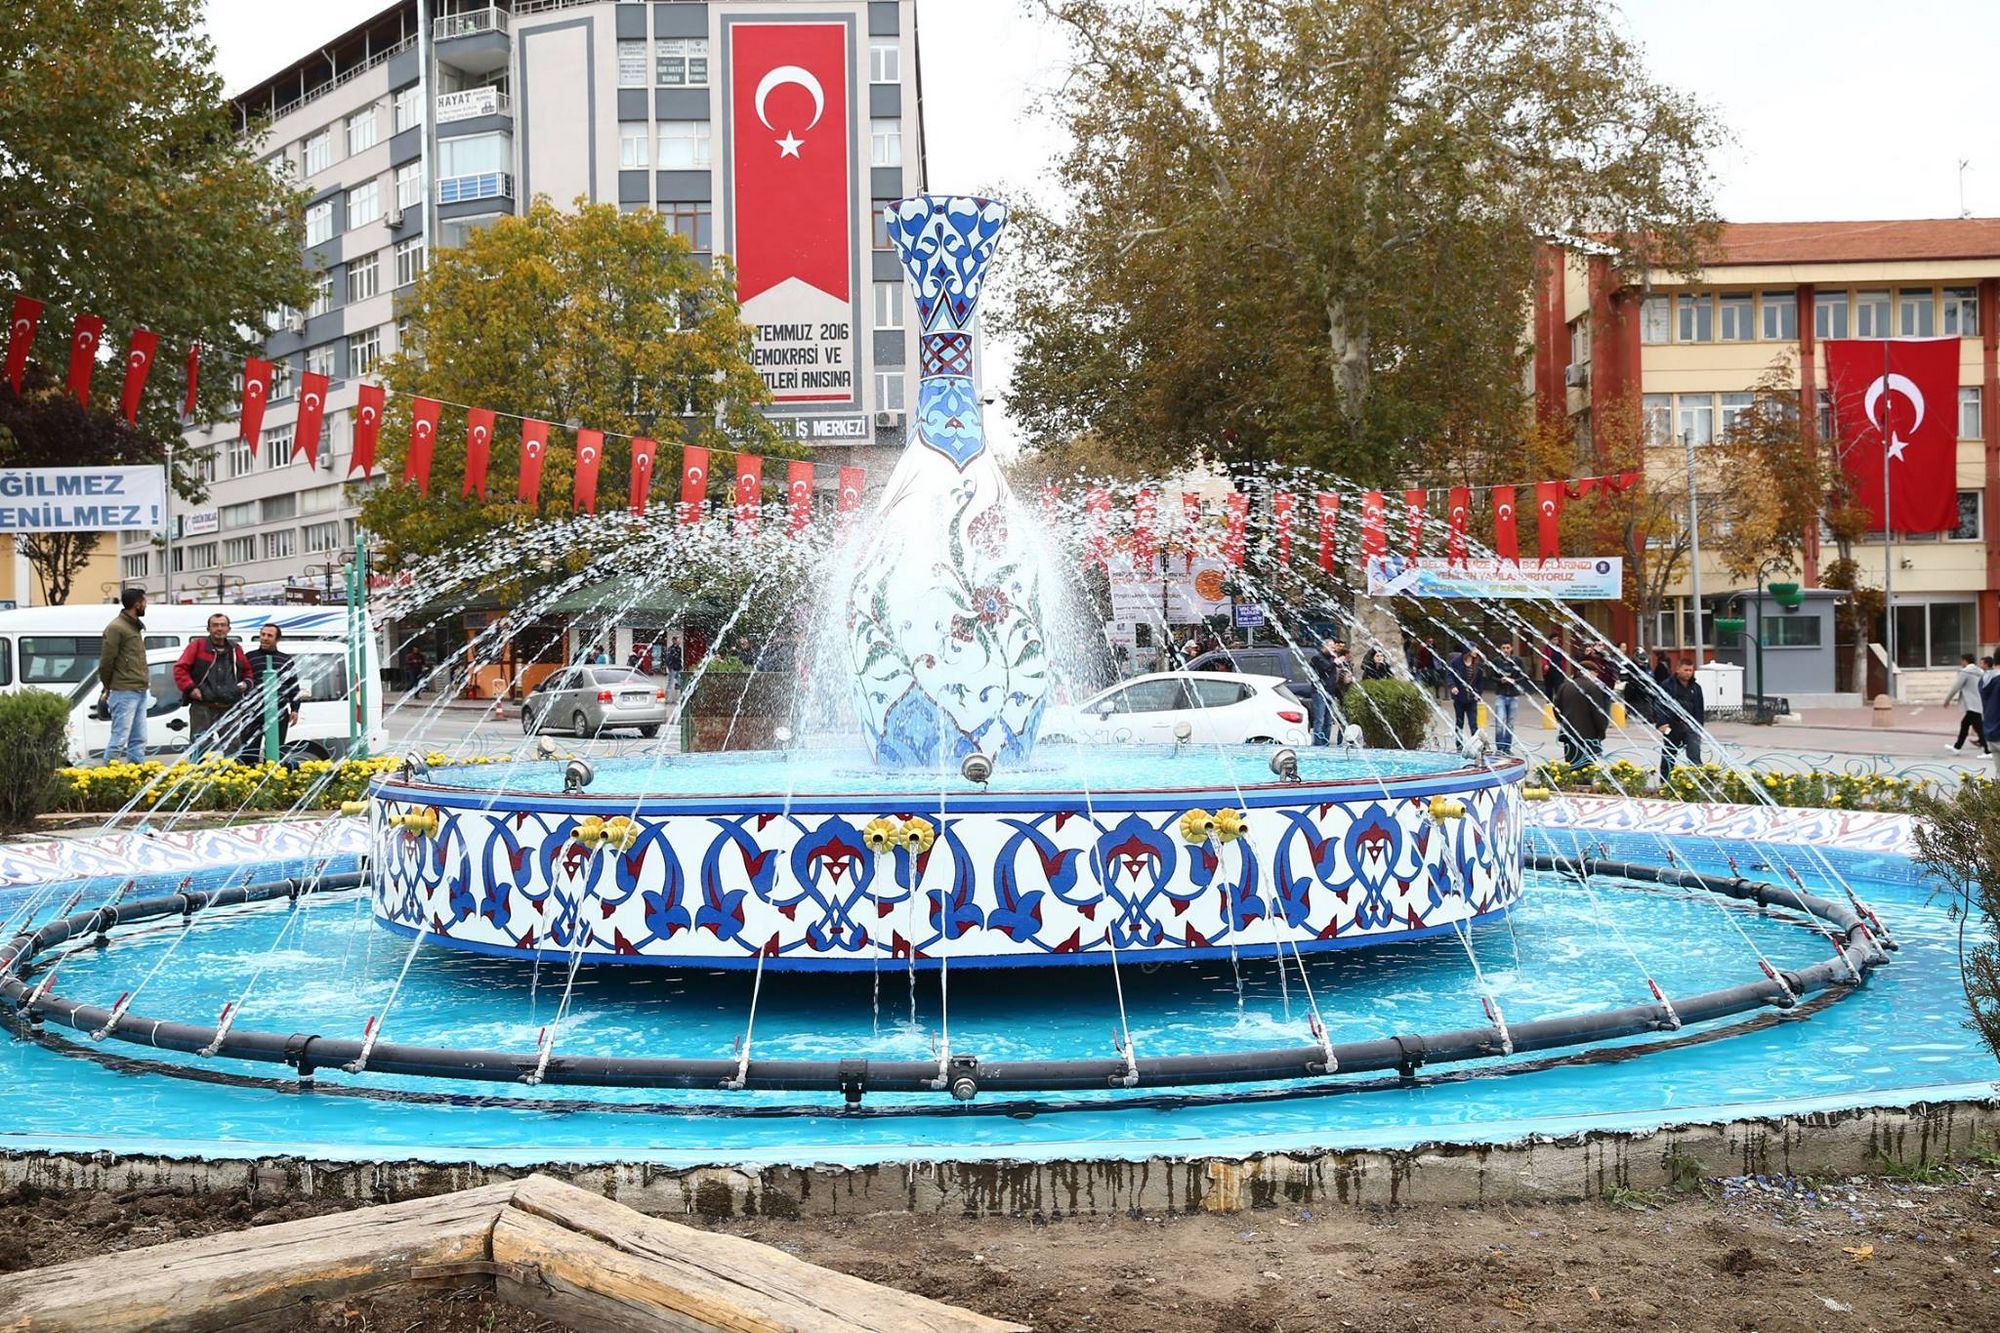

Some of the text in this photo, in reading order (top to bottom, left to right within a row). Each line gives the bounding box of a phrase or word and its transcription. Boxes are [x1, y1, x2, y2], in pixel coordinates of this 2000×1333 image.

[438, 93, 471, 107] HAYAT
[756, 323, 849, 341] TEMMUZ 2016
[747, 343, 842, 365] DEMOKRASİ VE
[801, 370, 851, 388] ANISINA
[795, 417, 809, 439] İŞ
[813, 416, 866, 437] MERKEZİ
